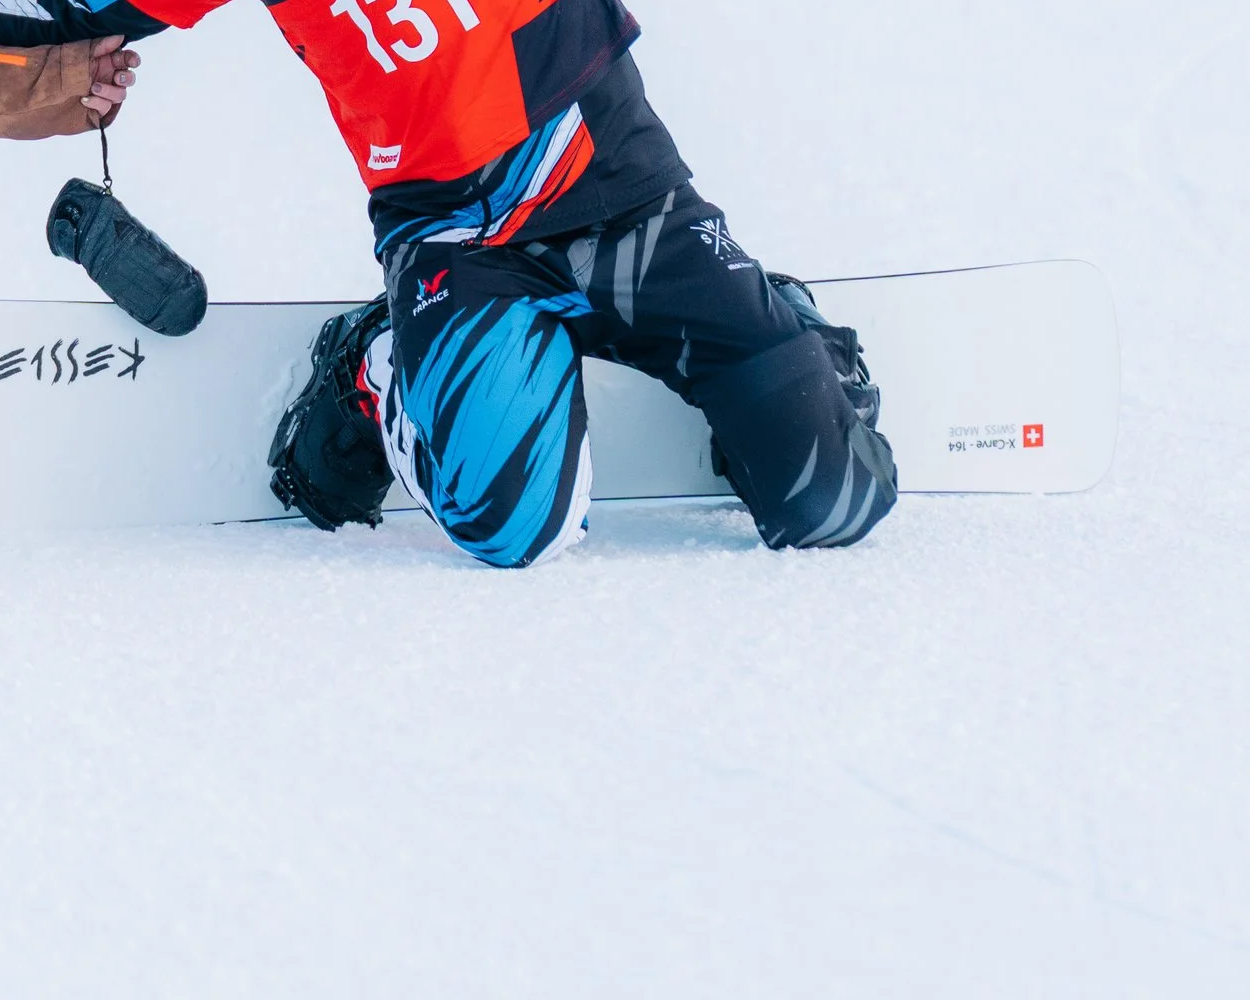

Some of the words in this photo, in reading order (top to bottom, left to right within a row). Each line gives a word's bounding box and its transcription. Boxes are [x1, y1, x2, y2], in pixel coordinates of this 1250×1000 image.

[412, 288, 450, 317] FRANCE
[949, 425, 979, 437] MADE
[984, 423, 1016, 436] SWISS
[948, 441, 967, 452] 164
[976, 438, 1016, 450] X-Carve
